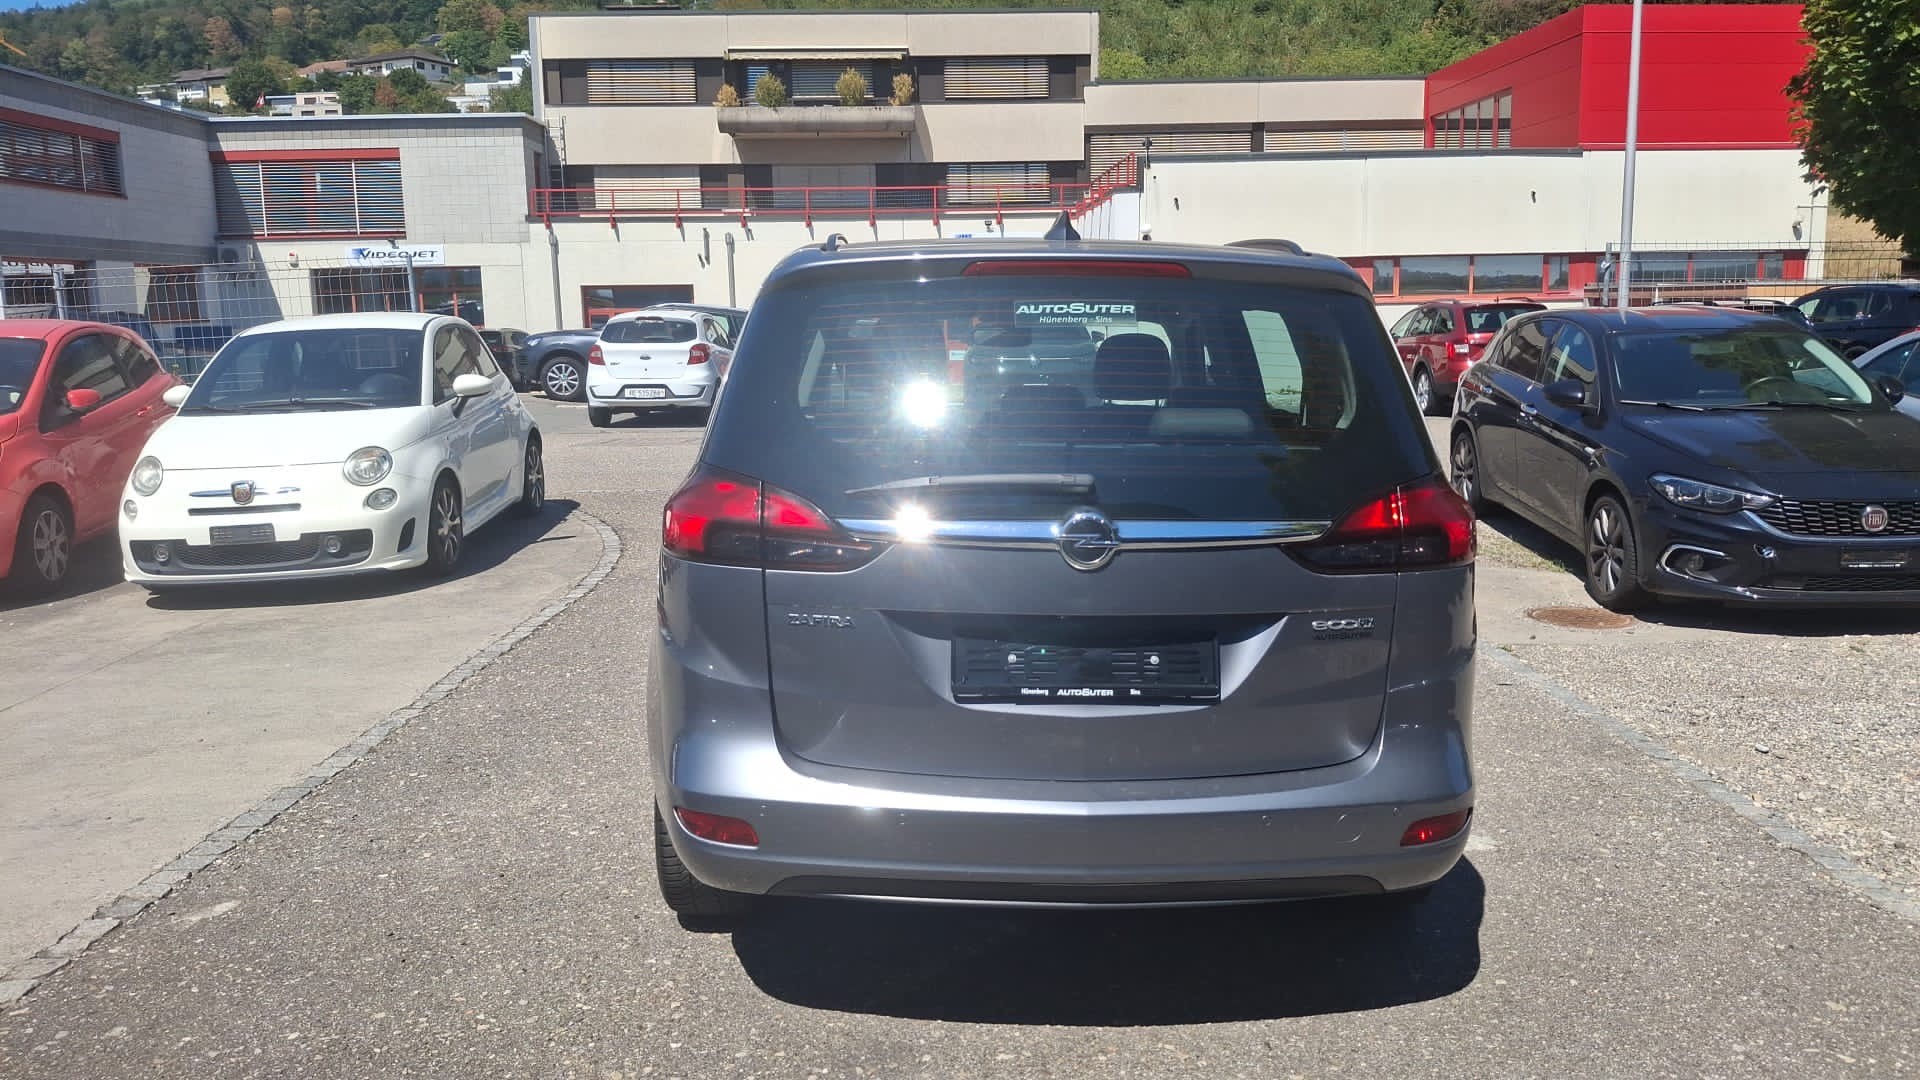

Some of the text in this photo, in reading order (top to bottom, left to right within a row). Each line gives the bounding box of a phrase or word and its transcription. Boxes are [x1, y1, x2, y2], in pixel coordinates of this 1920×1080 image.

[359, 248, 438, 259] VIDEOJET
[1039, 315, 1088, 324] Hünenberg
[1096, 315, 1112, 323] Sins
[788, 613, 854, 627] ZAFIRA
